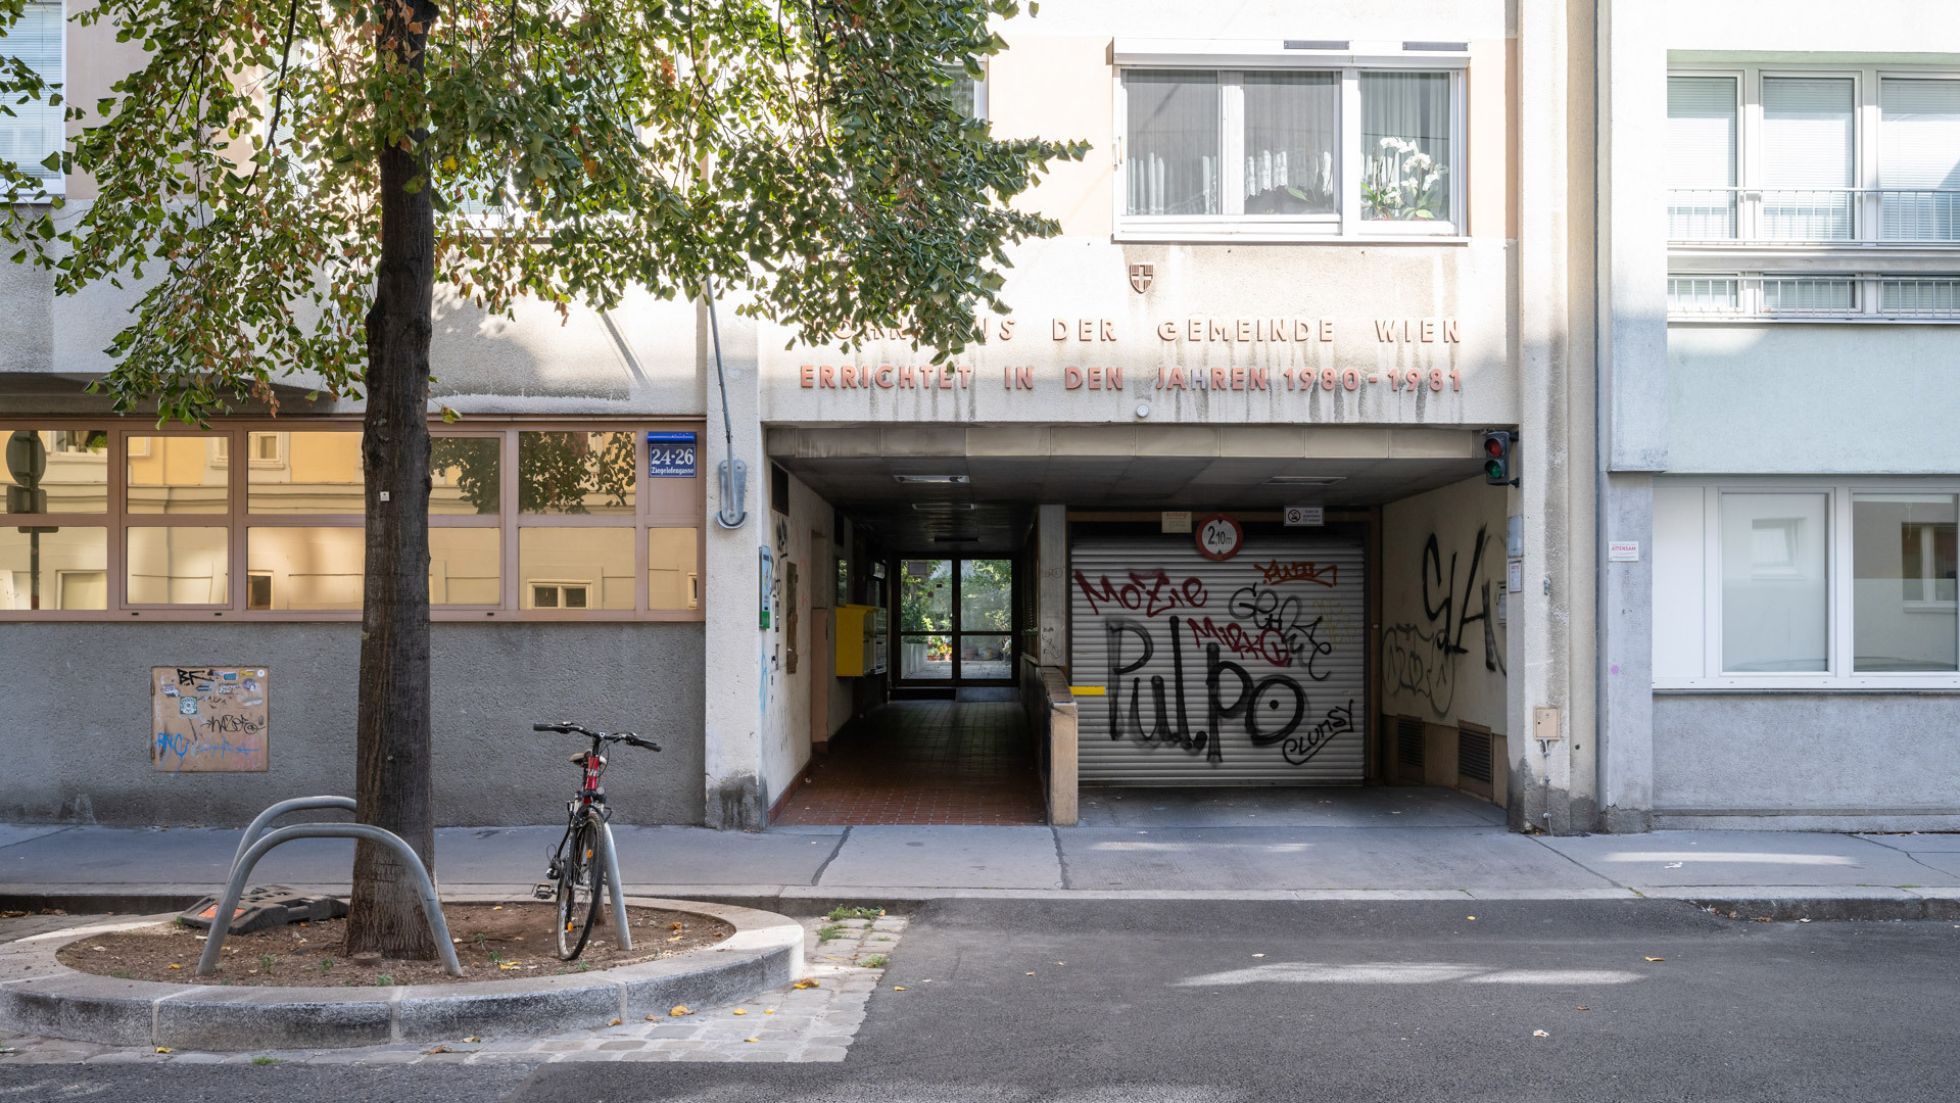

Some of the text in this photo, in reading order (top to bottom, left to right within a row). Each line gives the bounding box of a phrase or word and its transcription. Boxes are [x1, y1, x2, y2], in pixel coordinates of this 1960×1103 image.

[1052, 318, 1117, 342] DER
[1157, 319, 1333, 342] GEMEINDE
[1375, 319, 1461, 343] WIEN
[800, 364, 972, 389] ERRICHTET
[1004, 366, 1034, 390] IN
[1064, 367, 1124, 390] DEN
[1156, 367, 1268, 391] JAHREN
